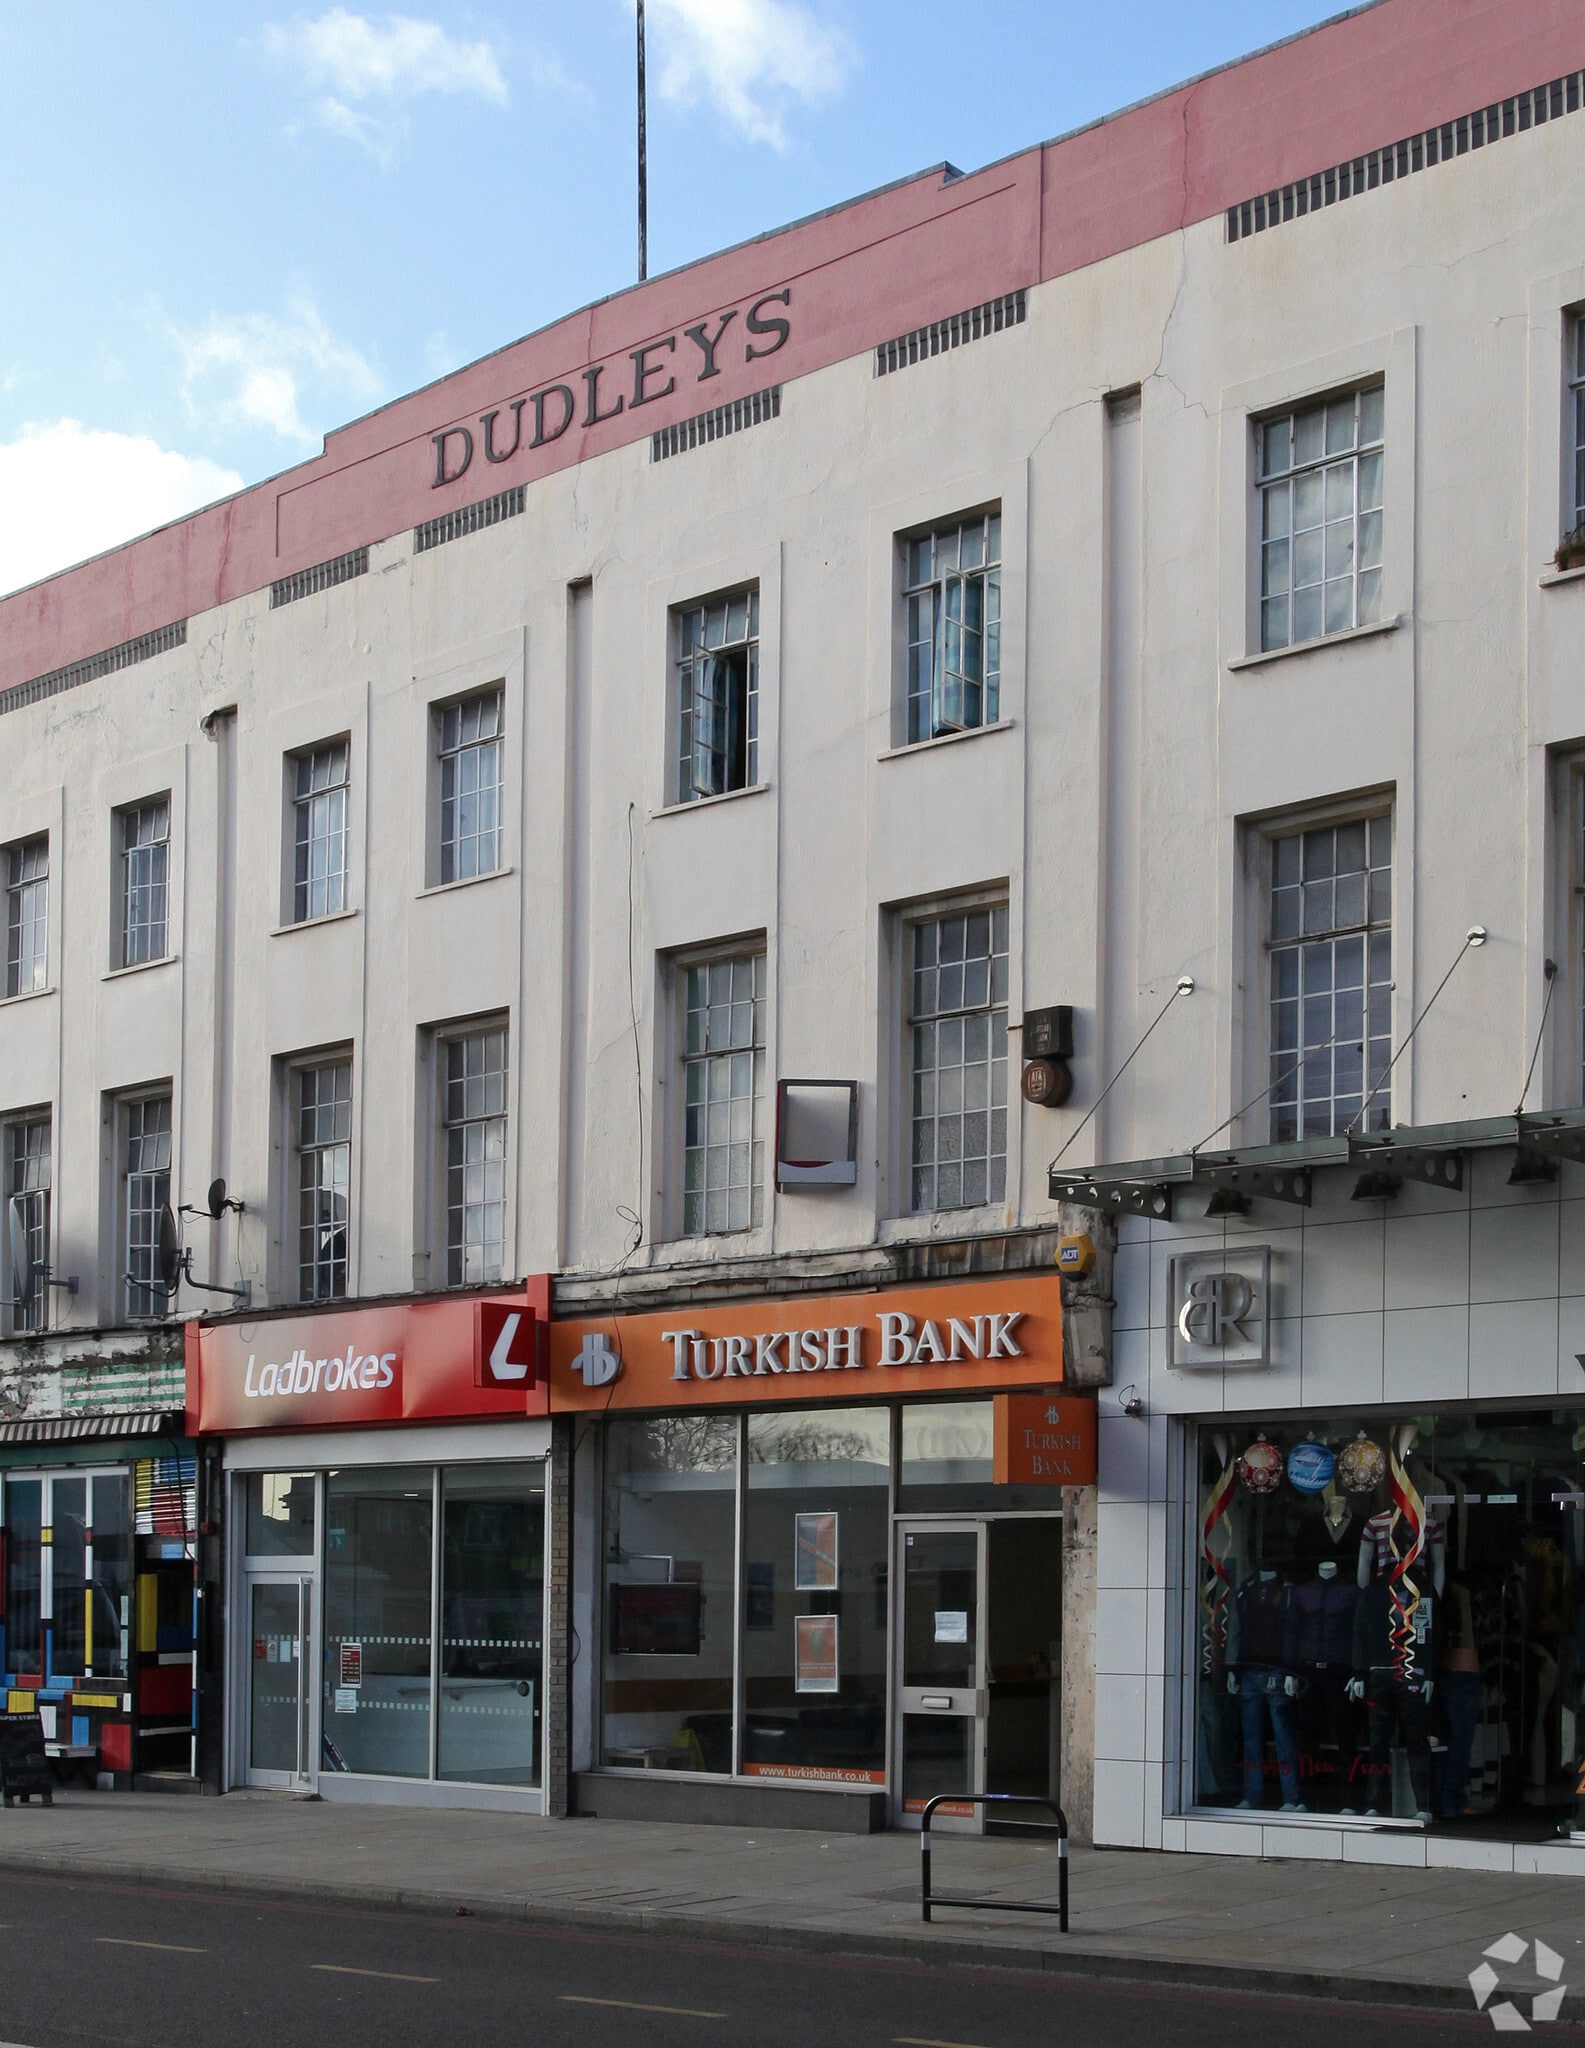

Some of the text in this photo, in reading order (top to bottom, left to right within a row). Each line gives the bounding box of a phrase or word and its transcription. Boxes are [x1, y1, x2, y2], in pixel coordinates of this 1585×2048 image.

[431, 288, 791, 489] DUDLEYS
[1061, 1249, 1078, 1260] ADT
[661, 1310, 1028, 1381] TURKISH BANK
[243, 1344, 397, 1398] Ladbrokes
[1024, 1429, 1082, 1450] TURKISH
[1032, 1455, 1072, 1475] BANK
[759, 1766, 871, 1783] www.turkishbank.co.uk
